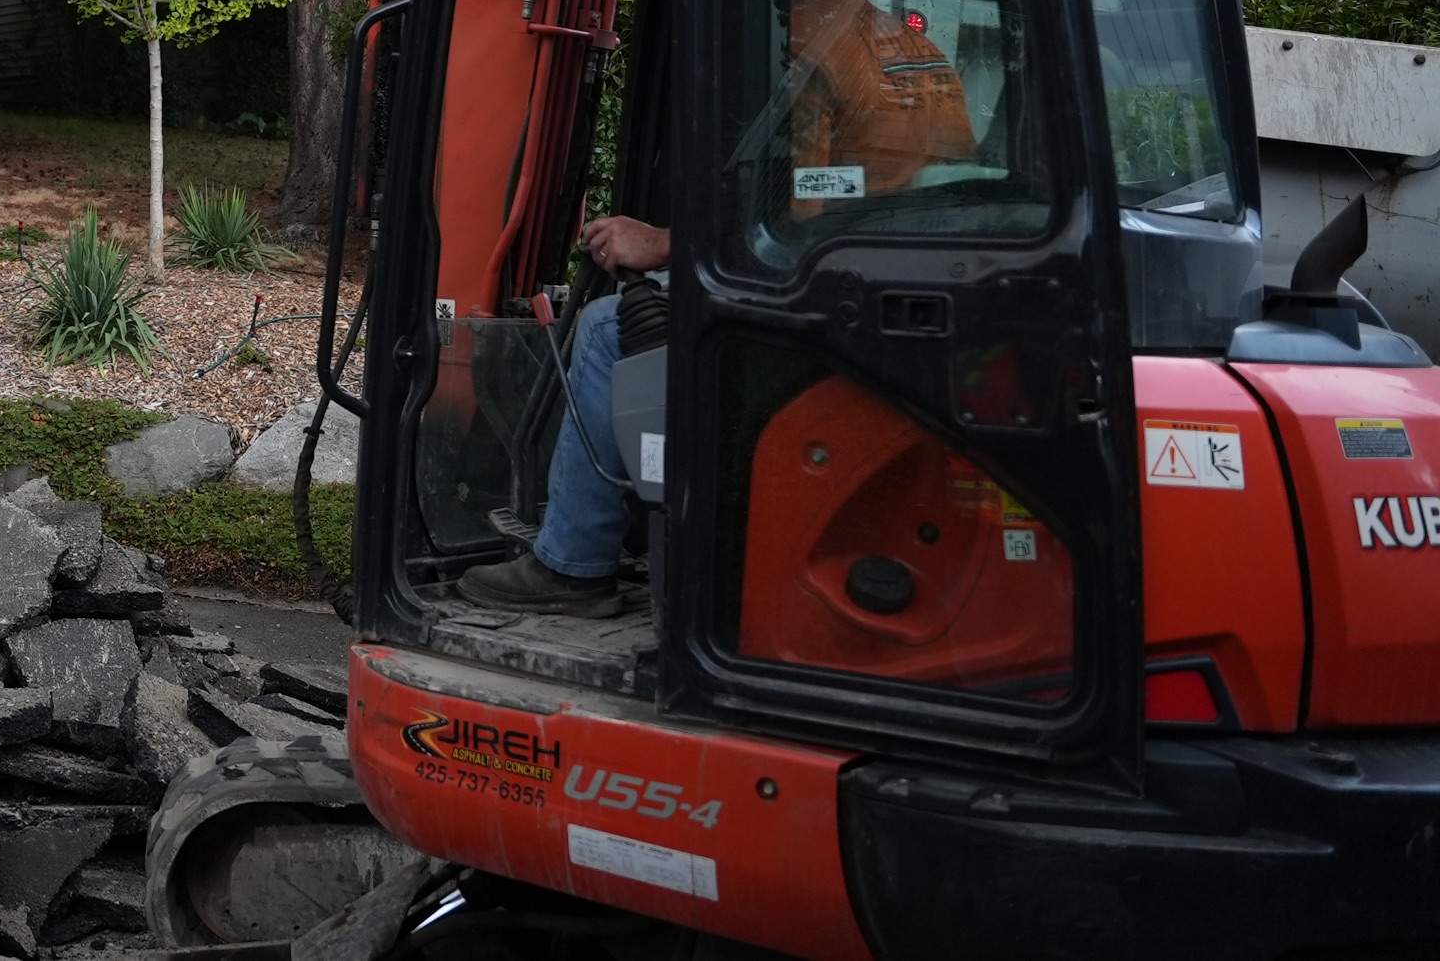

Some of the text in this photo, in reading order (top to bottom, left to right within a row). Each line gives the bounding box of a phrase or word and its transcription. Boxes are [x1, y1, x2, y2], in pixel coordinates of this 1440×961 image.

[796, 183, 836, 192] THEFT
[436, 718, 561, 769] JIREH
[452, 747, 553, 782] ASPHALT & CONCRETE
[415, 761, 546, 807] 425-737-6355
[563, 764, 723, 830] U55-4
